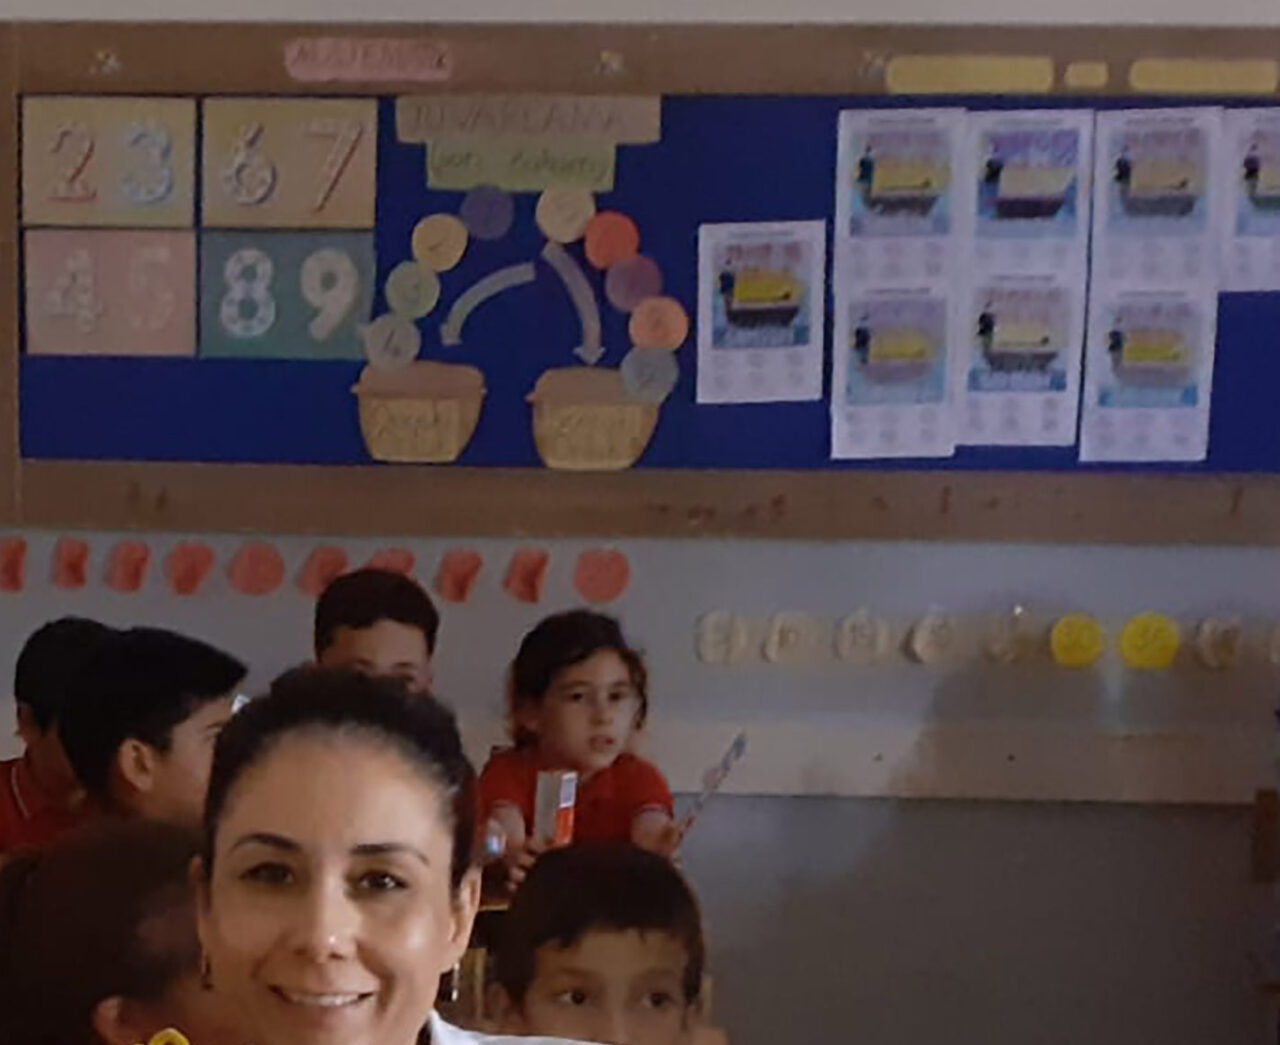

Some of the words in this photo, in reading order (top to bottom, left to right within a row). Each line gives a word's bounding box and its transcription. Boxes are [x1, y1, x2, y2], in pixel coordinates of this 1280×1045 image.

[48, 121, 98, 203] 2
[121, 121, 175, 204] 3
[225, 121, 279, 206] 6
[304, 121, 365, 214] 7
[40, 249, 104, 335] 4
[220, 249, 276, 337] 8
[300, 248, 359, 341] 9
